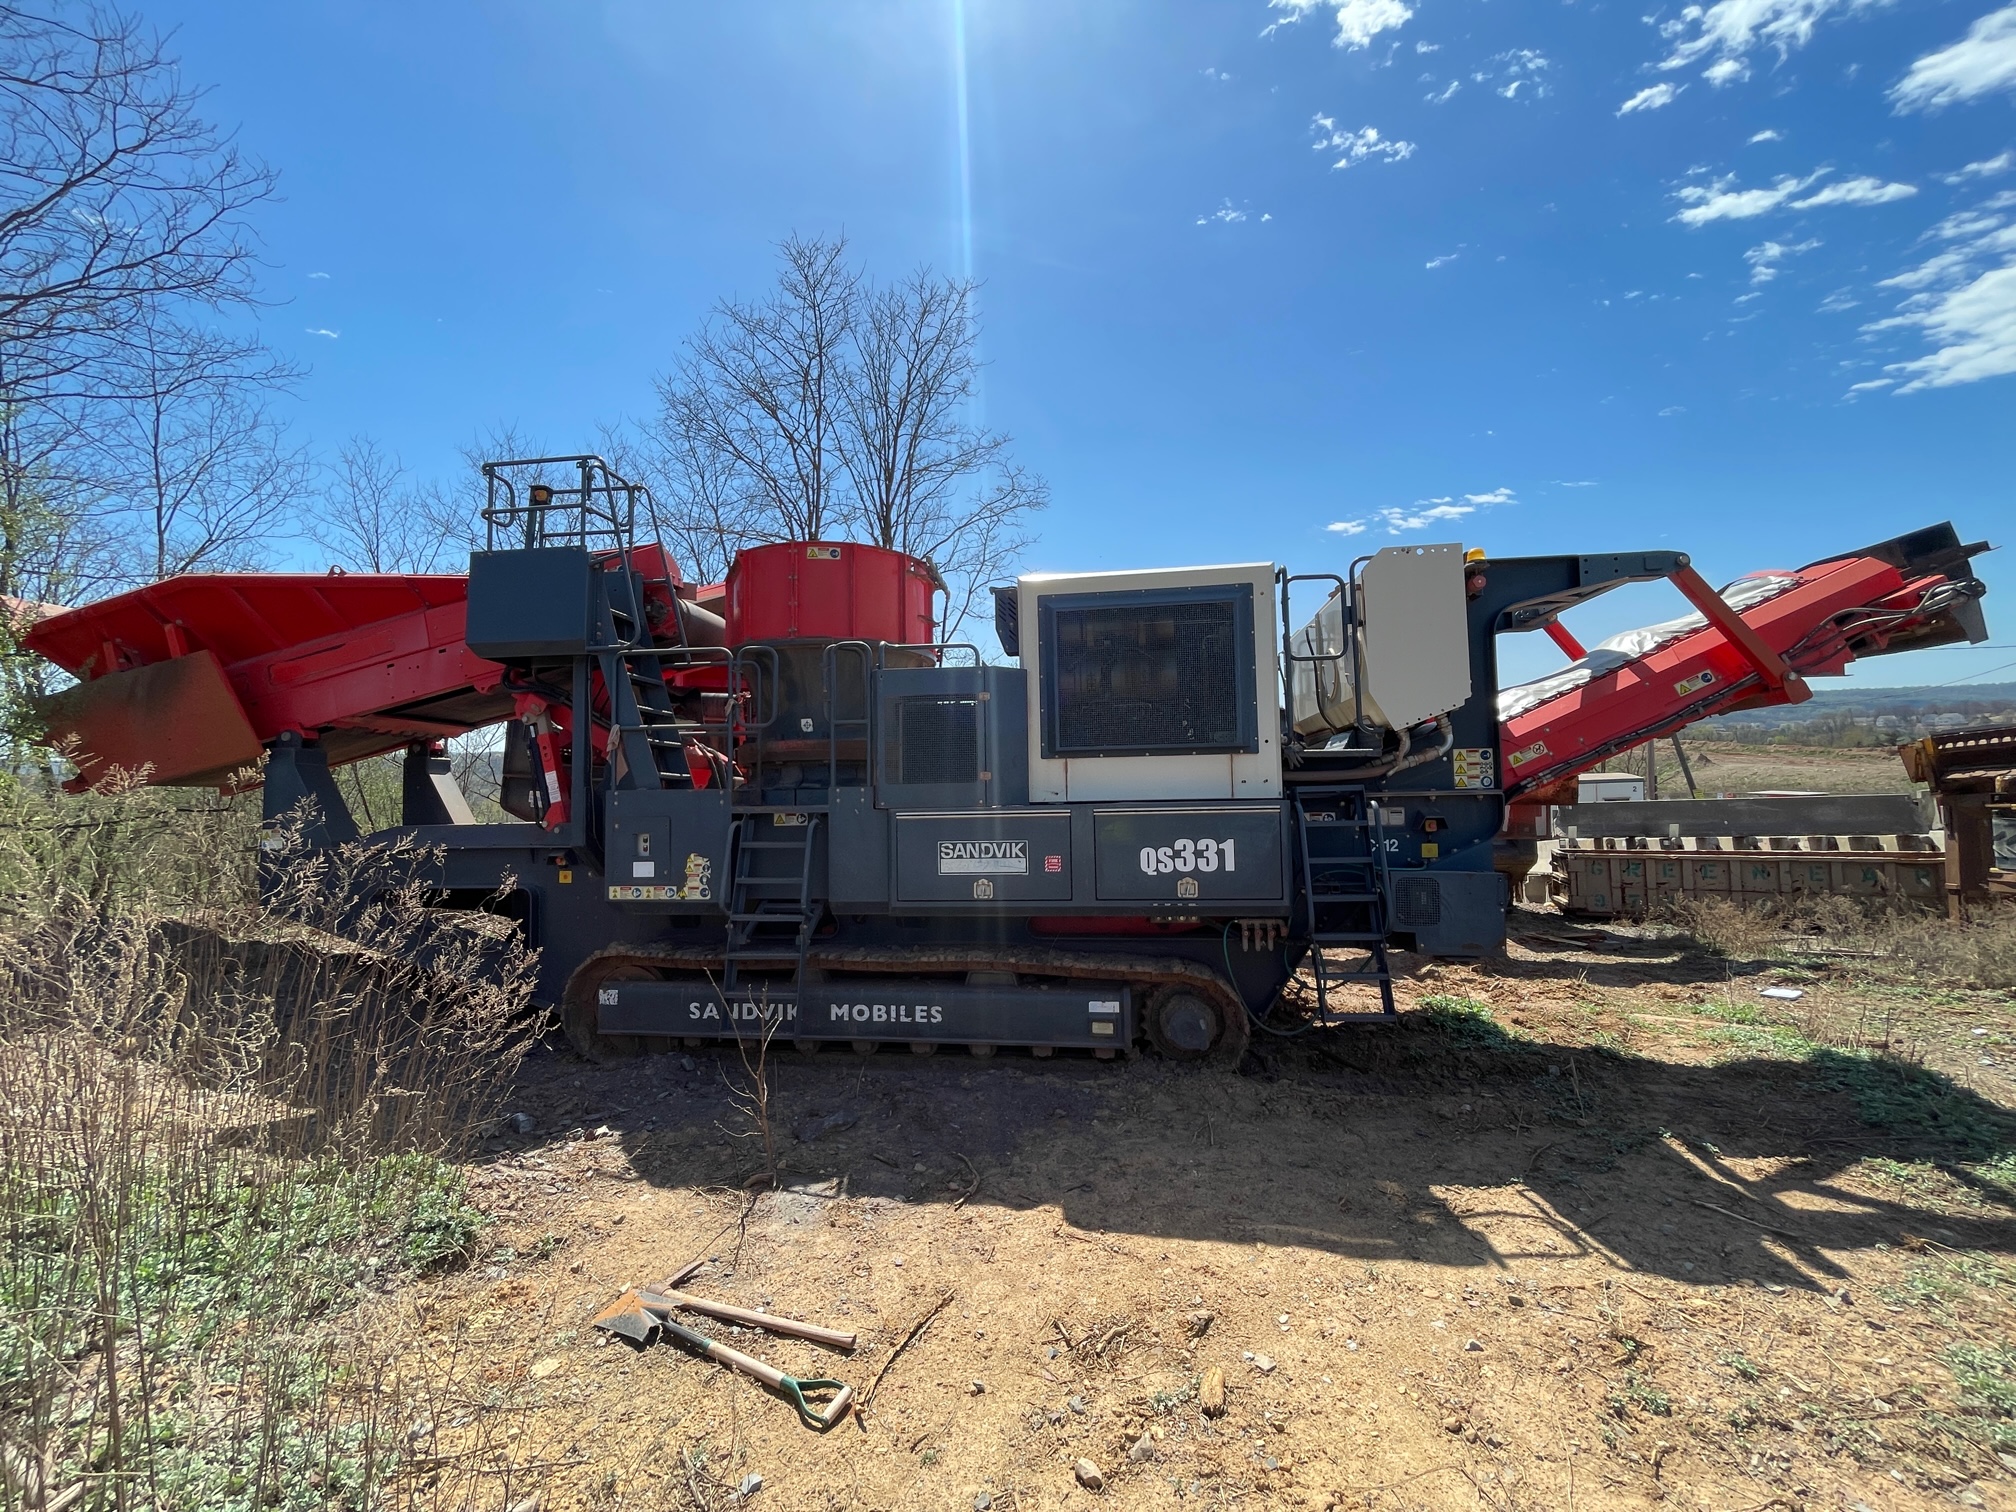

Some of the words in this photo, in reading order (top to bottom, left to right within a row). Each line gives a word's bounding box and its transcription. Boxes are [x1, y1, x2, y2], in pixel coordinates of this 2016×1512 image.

[1632, 785, 1638, 793] 2
[940, 843, 1025, 859] SANDVIK
[1139, 838, 1235, 875] QS331
[830, 1004, 943, 1023] MOBILES
